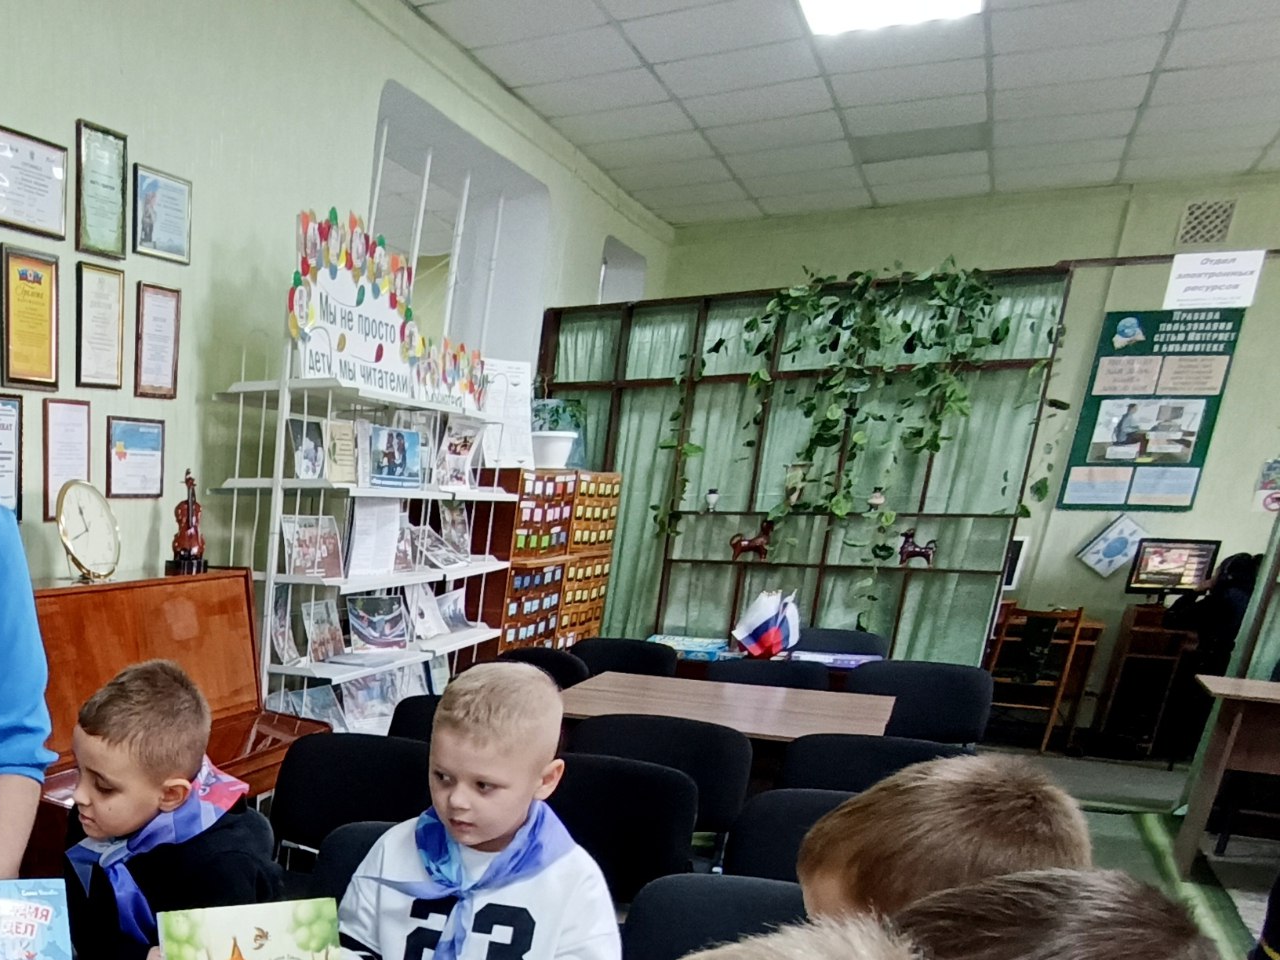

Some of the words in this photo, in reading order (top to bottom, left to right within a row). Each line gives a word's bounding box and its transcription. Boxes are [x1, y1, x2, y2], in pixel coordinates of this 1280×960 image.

[319, 292, 337, 324] Мы
[340, 307, 354, 331] не
[358, 313, 396, 344] просто
[339, 358, 356, 381] мы
[360, 364, 408, 394] читатели
